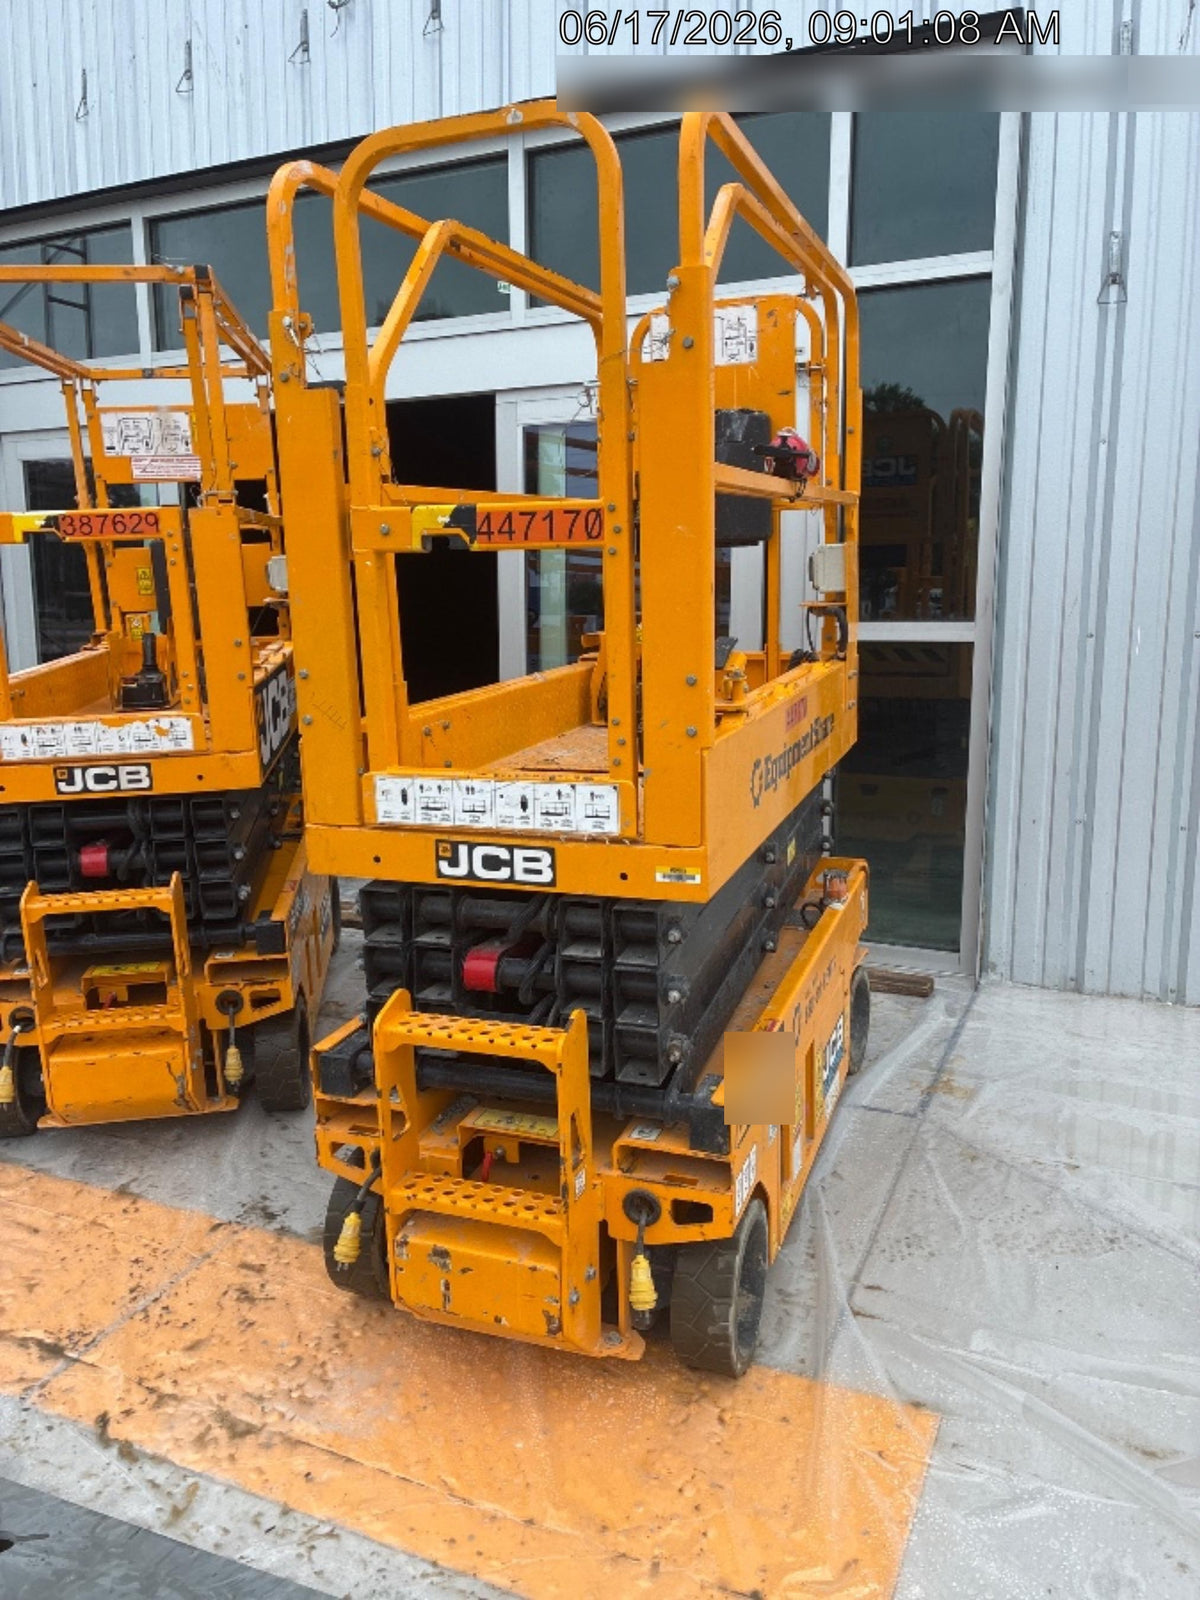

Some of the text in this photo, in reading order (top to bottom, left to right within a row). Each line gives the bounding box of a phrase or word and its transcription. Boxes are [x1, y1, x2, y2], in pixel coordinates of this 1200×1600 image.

[61, 512, 159, 536] 387629
[478, 508, 602, 541] 447170
[261, 670, 288, 765] JCB
[57, 766, 150, 793] JCB
[438, 844, 553, 883] JCB
